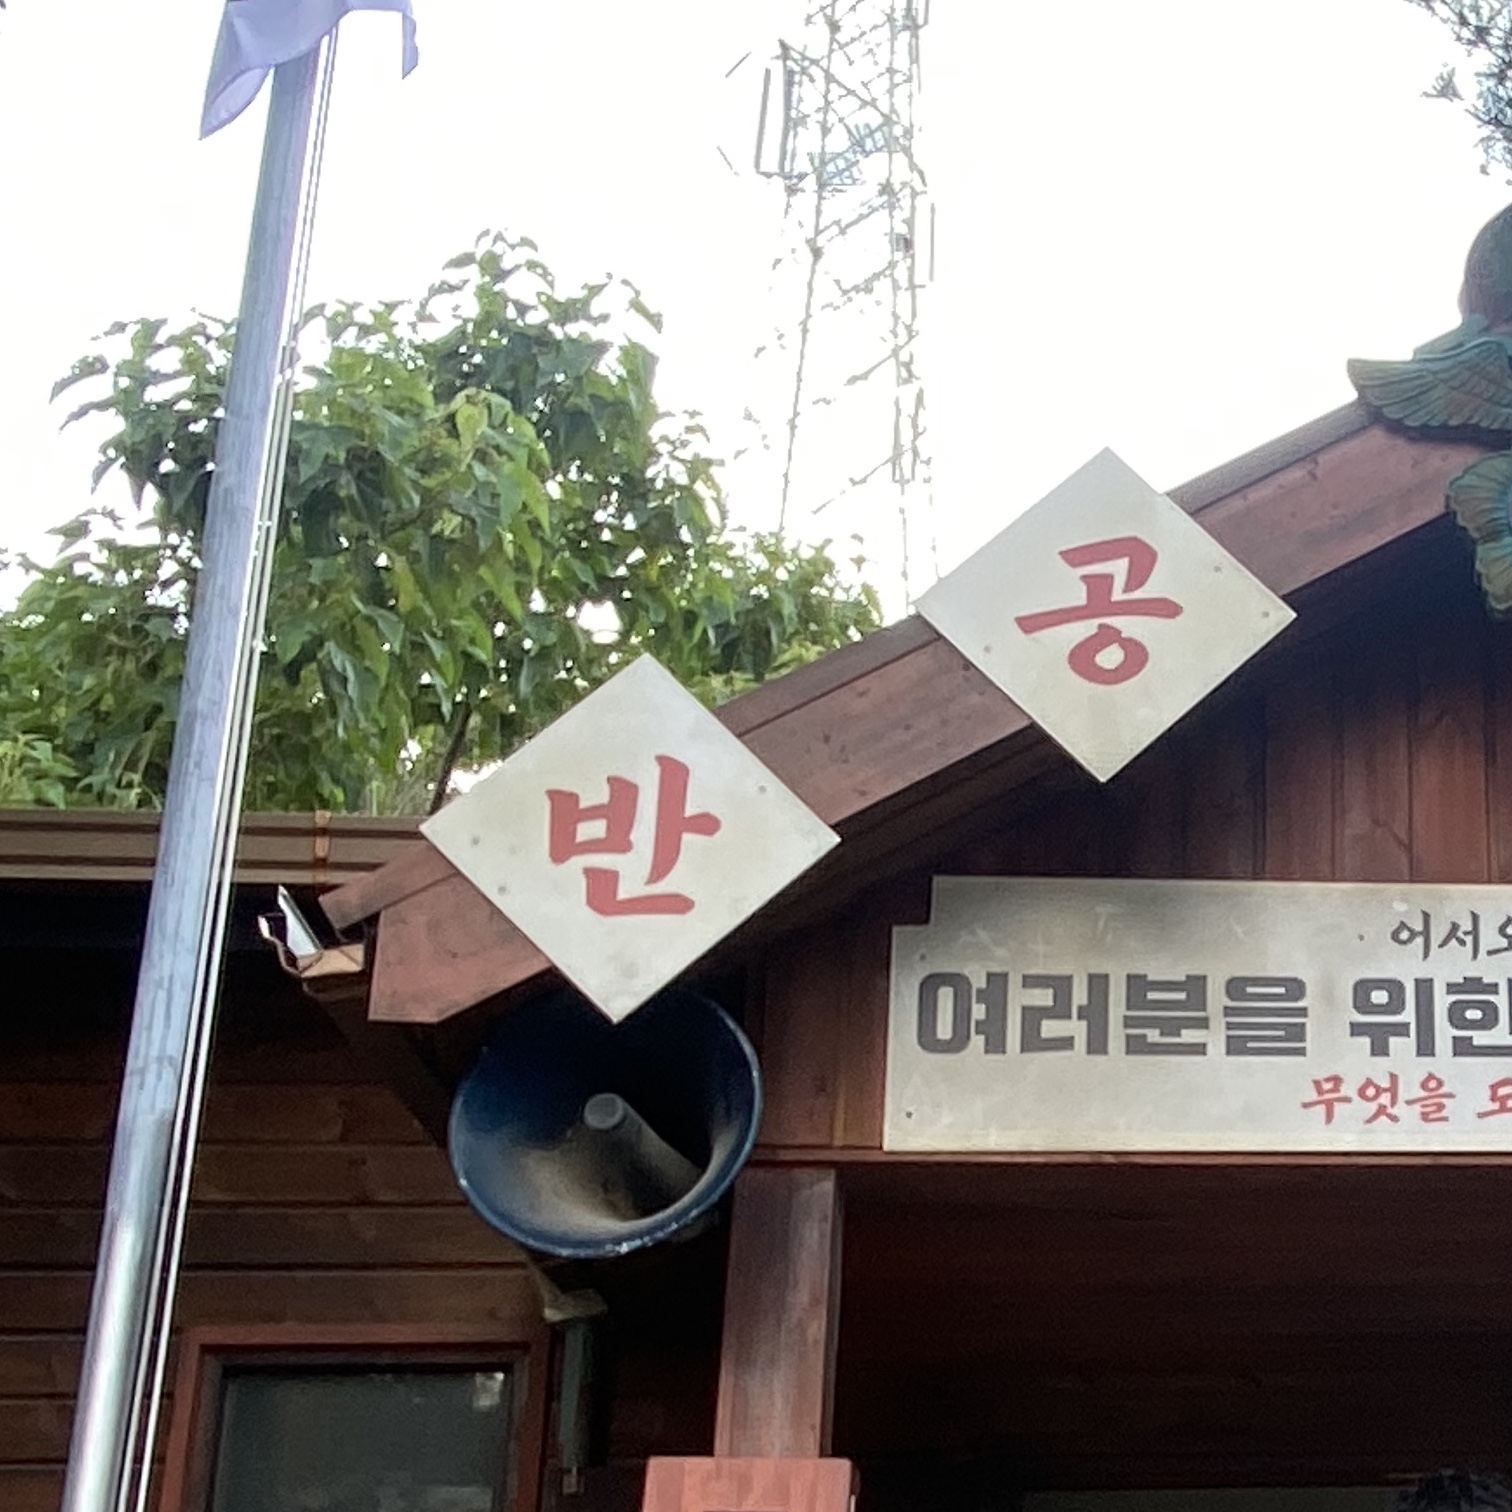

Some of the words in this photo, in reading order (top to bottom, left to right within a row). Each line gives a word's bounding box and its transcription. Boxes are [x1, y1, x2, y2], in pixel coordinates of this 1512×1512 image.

[546, 755, 721, 916] 반
[1015, 536, 1184, 686] 공
[916, 971, 1309, 1057] 여러분을
[1301, 1071, 1456, 1125] 무엇을
